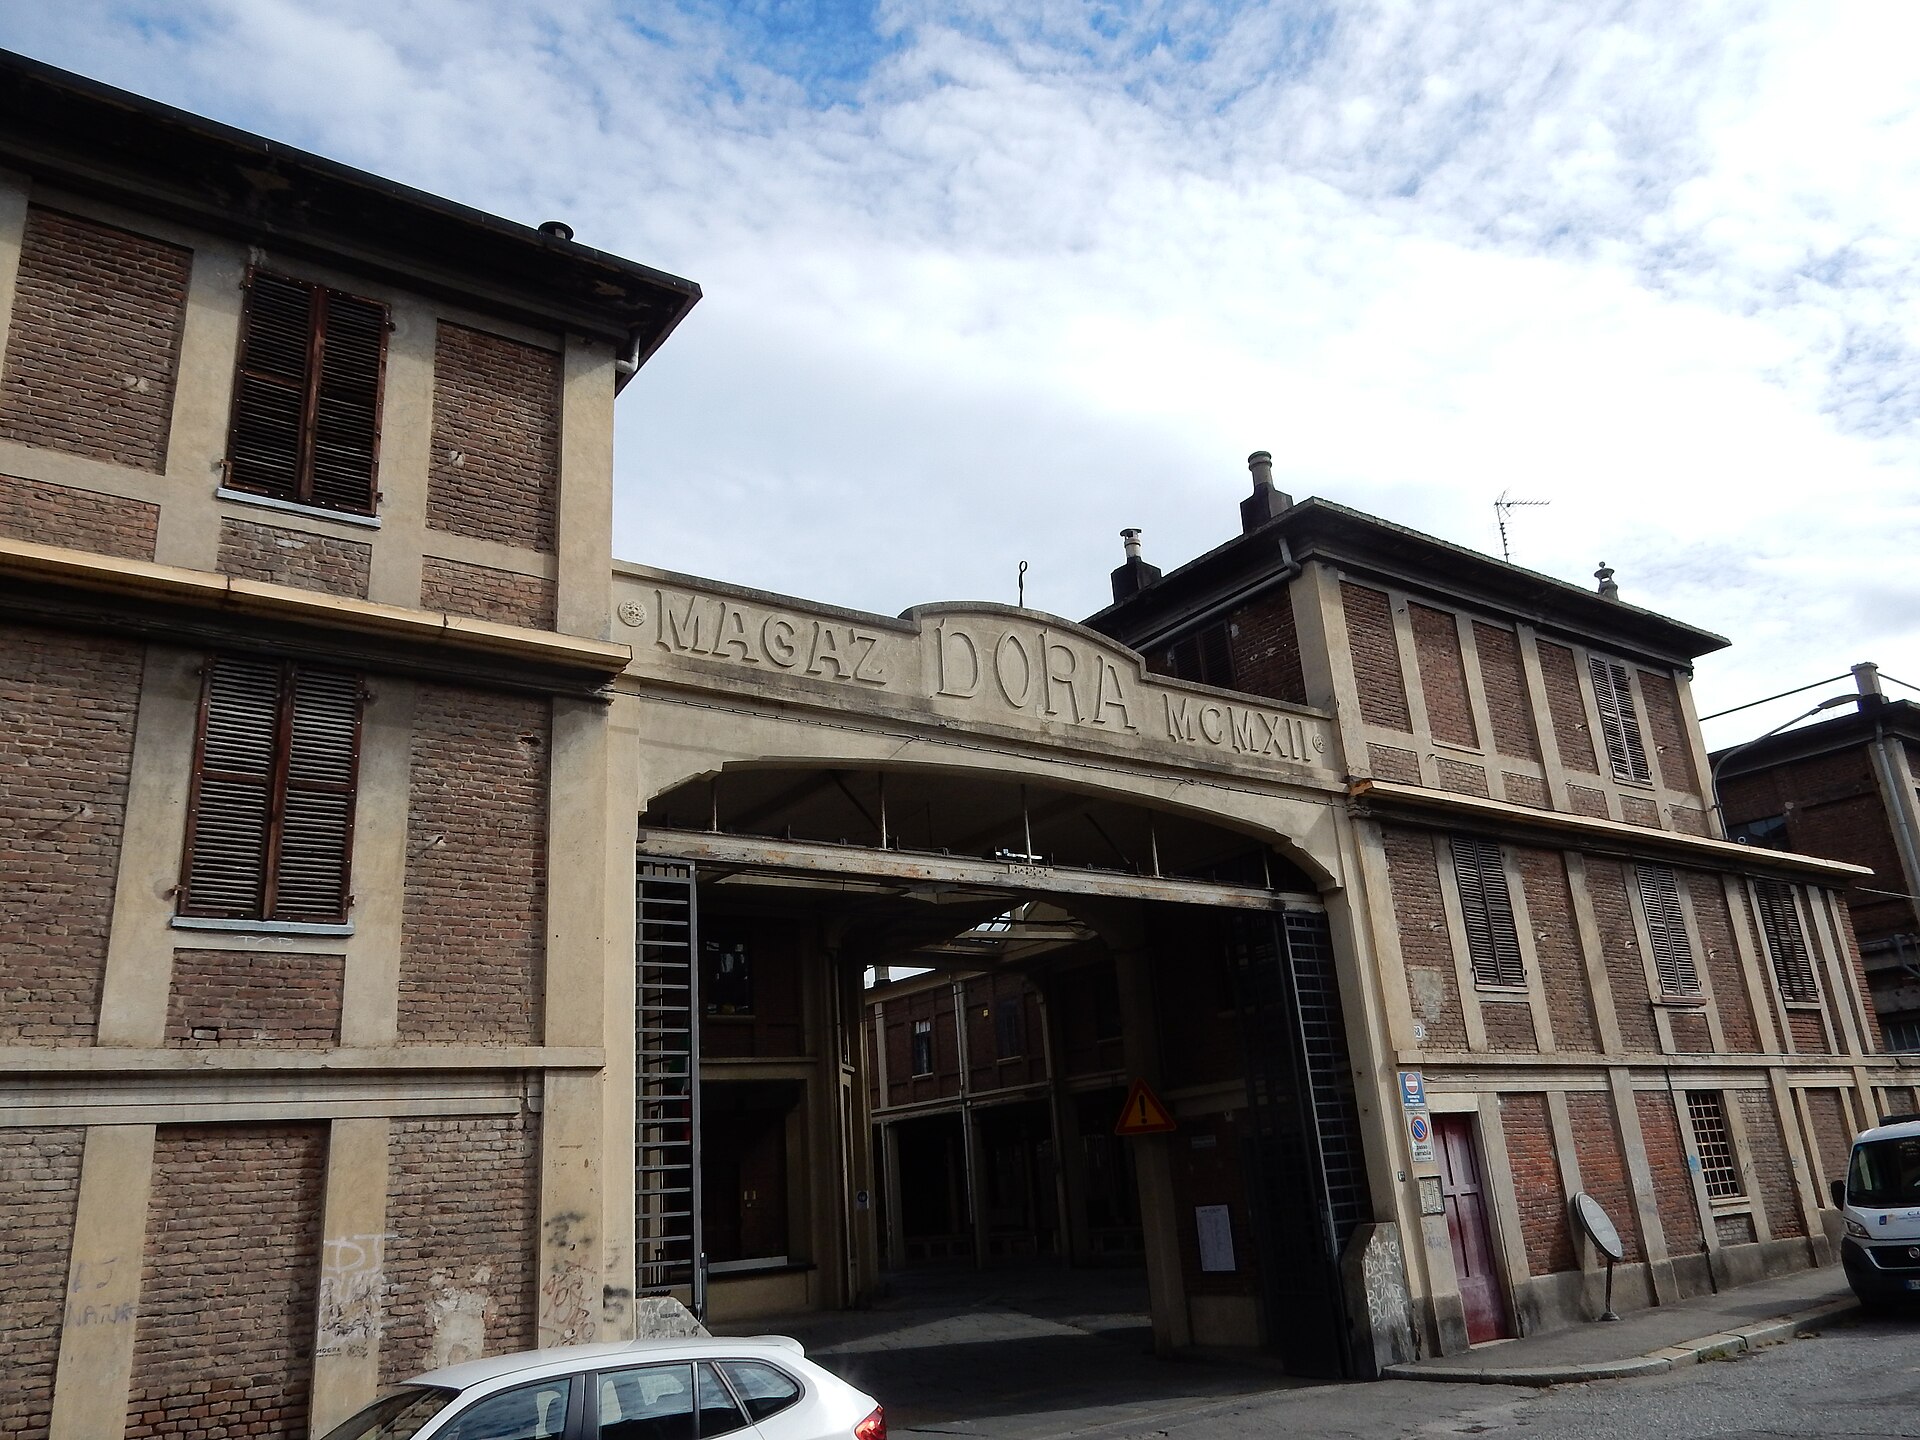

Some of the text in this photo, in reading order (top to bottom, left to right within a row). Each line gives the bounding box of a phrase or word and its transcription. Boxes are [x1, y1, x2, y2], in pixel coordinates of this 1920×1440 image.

[652, 588, 1313, 763] MAGAZ DORA MCMXII
